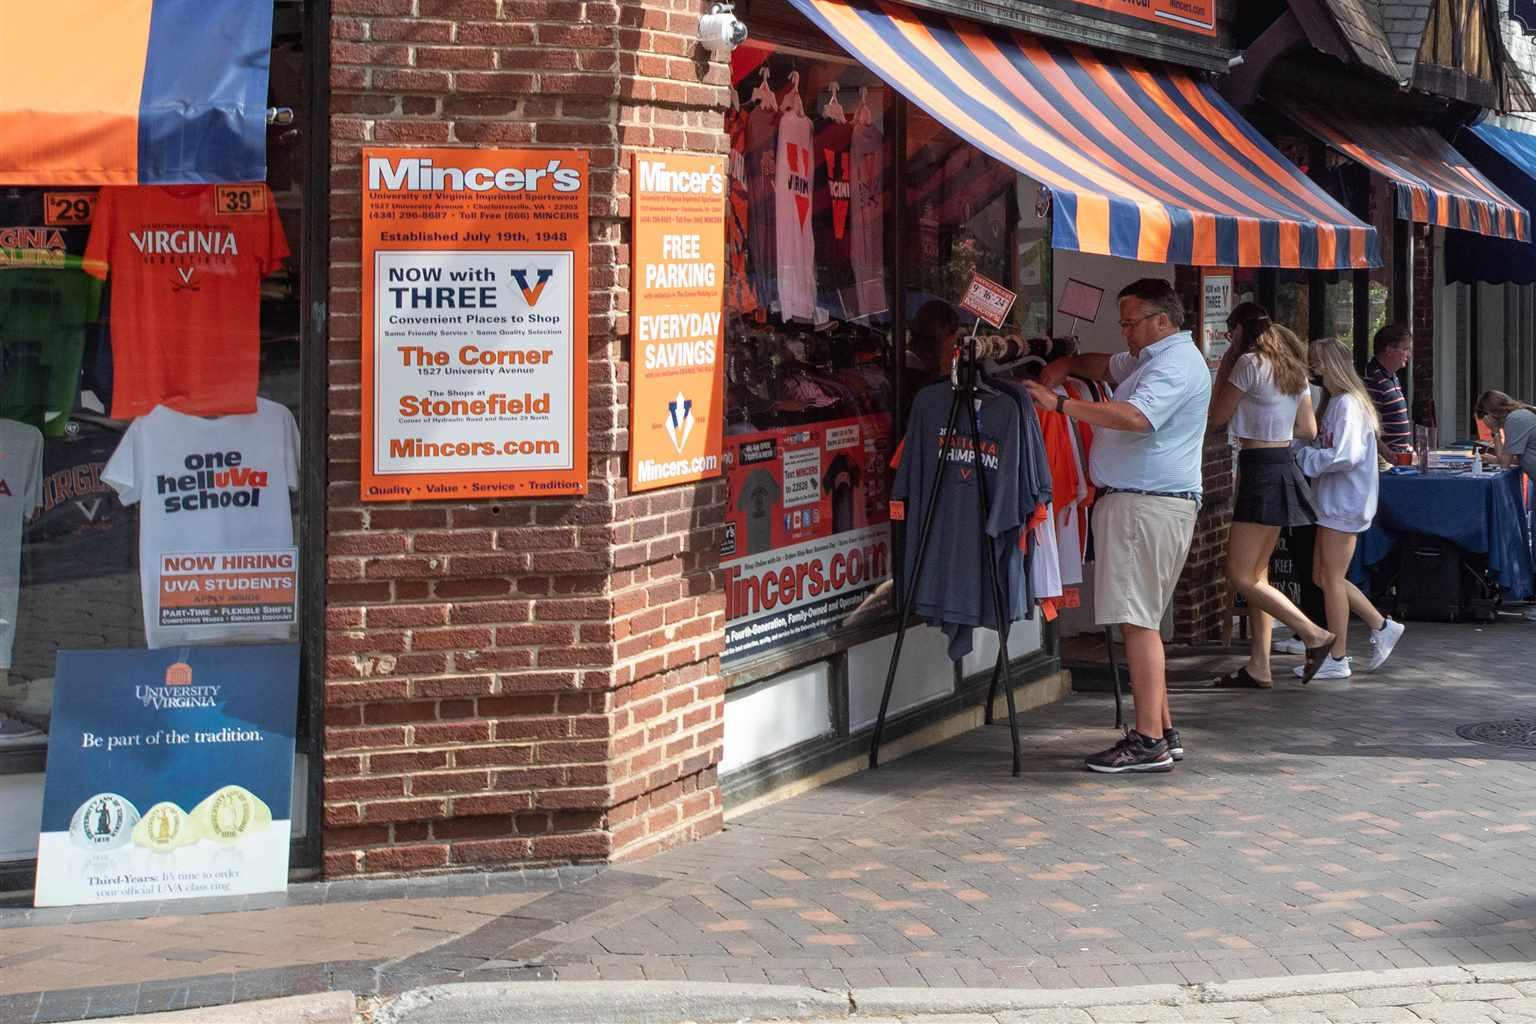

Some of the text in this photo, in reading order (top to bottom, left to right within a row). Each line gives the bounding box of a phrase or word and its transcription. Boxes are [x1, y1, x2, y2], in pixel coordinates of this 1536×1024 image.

[368, 157, 582, 193] Mincer's
[639, 160, 723, 194] Mincer's
[369, 193, 419, 202] University
[436, 192, 473, 202] Virginia
[476, 193, 522, 202] Imprinted
[525, 193, 578, 201] Sportswear
[129, 230, 238, 256] VIRGINIA
[380, 231, 567, 243] Established July 19th, 1948
[663, 234, 701, 260] FREE
[389, 267, 496, 282] NOW with
[645, 263, 716, 289] PARKING
[388, 287, 497, 309] THREE
[389, 314, 560, 325] Convenient Places to Shop
[639, 311, 721, 341] EVERYDAY
[397, 345, 553, 367] The Corner
[645, 340, 715, 369] SAVINGS
[445, 367, 495, 376] University
[498, 367, 535, 375] Avenue
[399, 393, 550, 417] Stonefield
[390, 439, 560, 459] Mincers.com
[184, 451, 242, 471] one
[637, 455, 717, 483] Mincers.com
[157, 467, 268, 495] helluVa
[369, 481, 580, 496] Quality Value Service Tradition
[165, 488, 260, 513] school
[164, 554, 293, 572] NOW HIRING
[164, 577, 292, 593] UVA STUDENTS
[163, 606, 292, 617] PART-TIME FLEXIBLE SHIFTS
[135, 685, 221, 700] UNIVERSITY
[152, 695, 217, 710] VIRGINIA
[82, 727, 264, 751] Be part of the tradition.
[87, 874, 159, 886] Third-Years:
